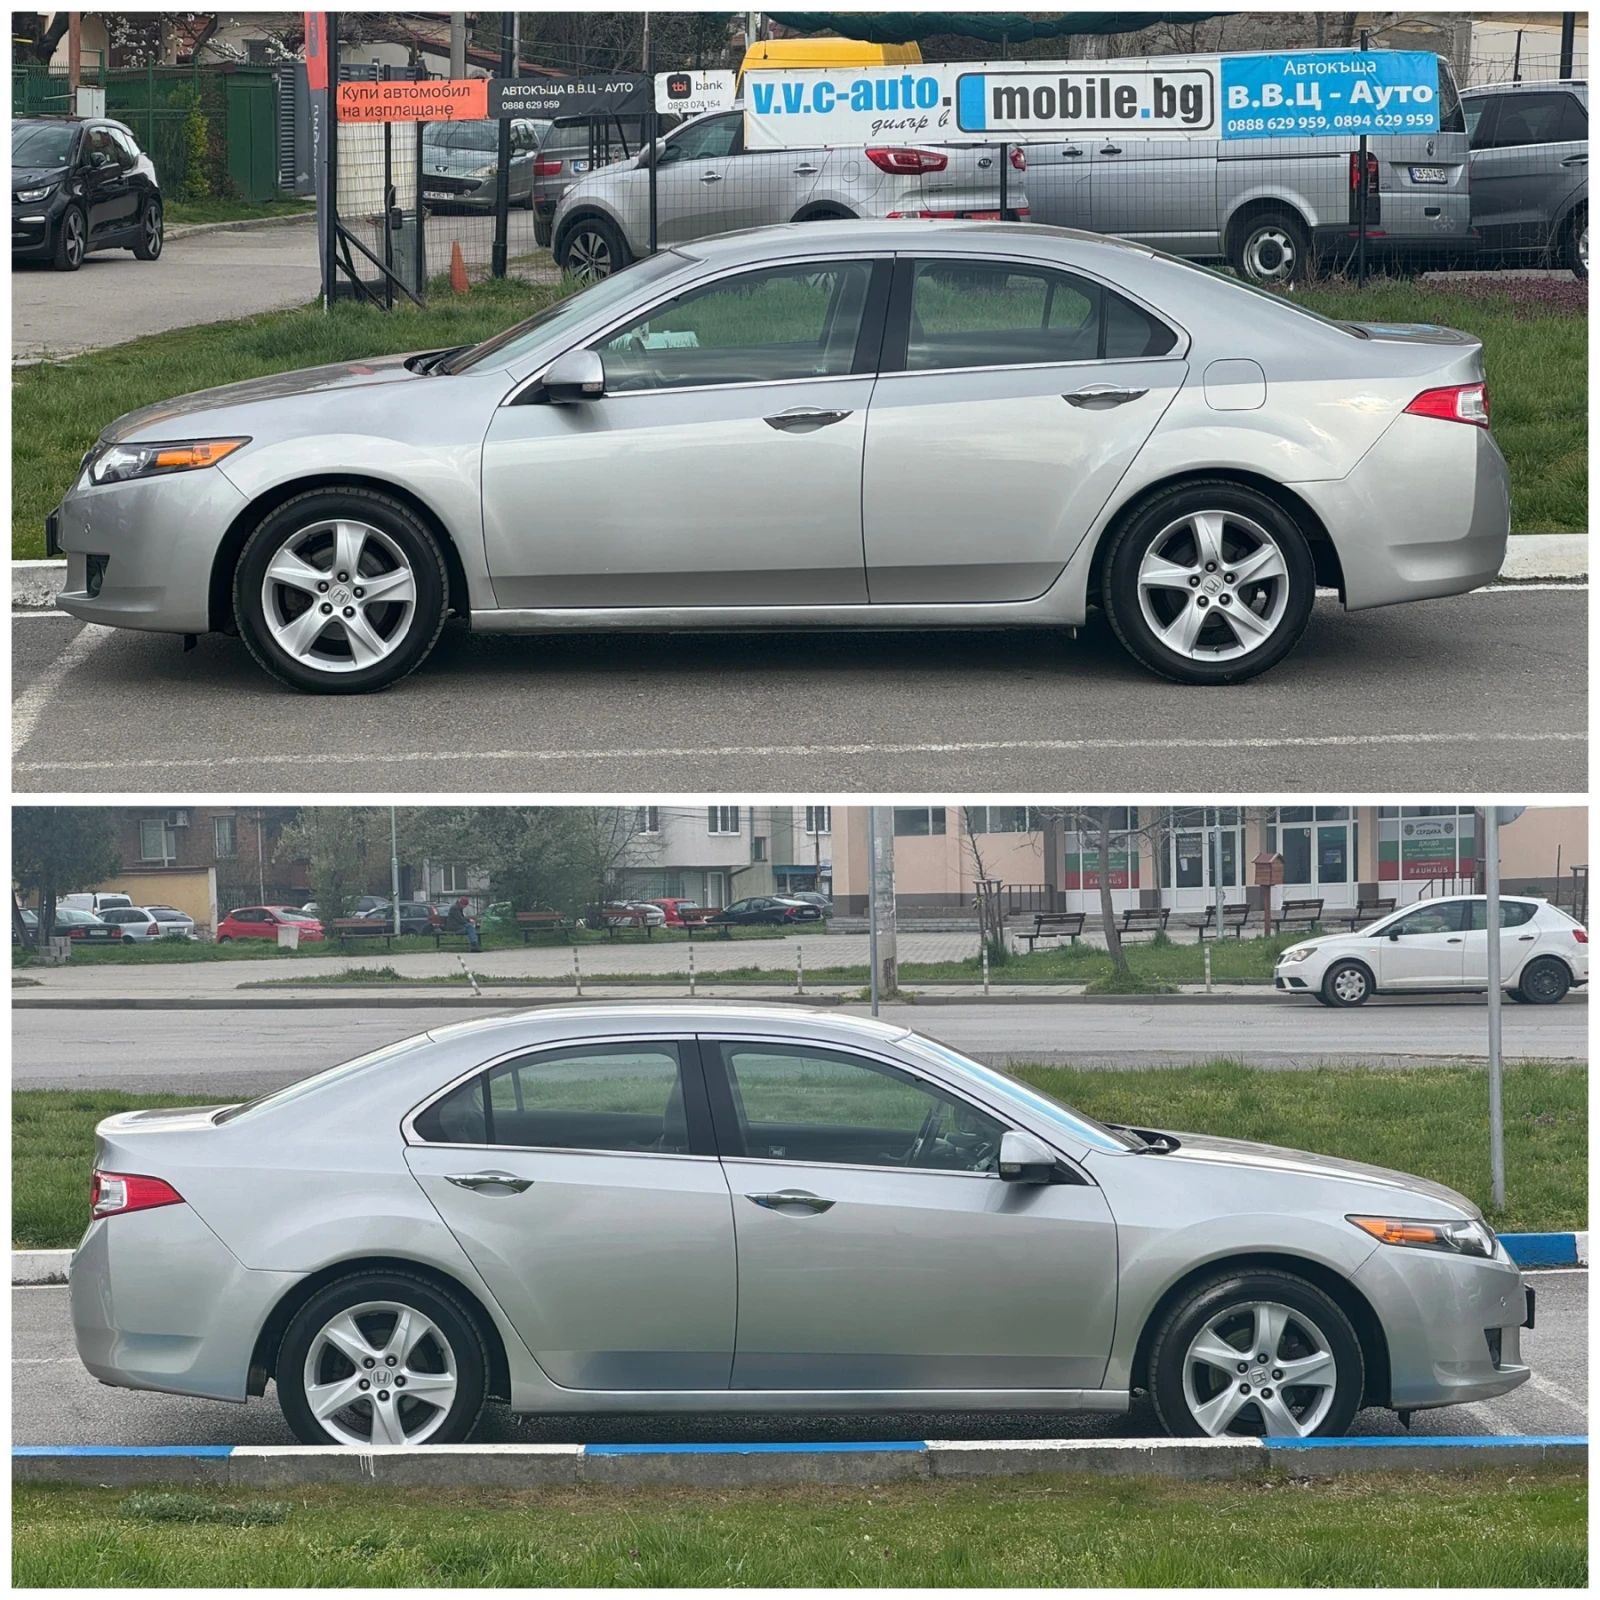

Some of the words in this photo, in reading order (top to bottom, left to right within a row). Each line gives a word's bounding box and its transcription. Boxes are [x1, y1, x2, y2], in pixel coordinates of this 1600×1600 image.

[1283, 60, 1376, 76] Автокъща
[342, 86, 379, 102] Купи
[383, 84, 471, 99] автомобил
[501, 84, 565, 96] АВТОКЪЩА
[567, 83, 596, 95] В.В.Ц
[605, 82, 634, 93] АУТО
[672, 81, 687, 92] tbi
[695, 80, 723, 91] bank
[992, 77, 1203, 124] mobile.bg
[1228, 82, 1322, 111] В.В.Ц
[1350, 80, 1433, 110] Ауто
[342, 106, 360, 117] на
[365, 104, 454, 117] изплащане
[502, 101, 524, 110] 0888
[526, 101, 542, 109] 629
[543, 100, 560, 109] 959
[667, 101, 689, 110] 0893
[690, 100, 705, 109] 074
[707, 100, 721, 108] 154
[871, 115, 929, 137] дилър
[938, 109, 950, 128] в
[1228, 118, 1264, 132] 0888
[1267, 117, 1295, 130] 629
[1298, 116, 1330, 130] 959,
[1334, 114, 1371, 127] 0894
[1374, 113, 1403, 126] 629
[1405, 113, 1434, 126] 959
